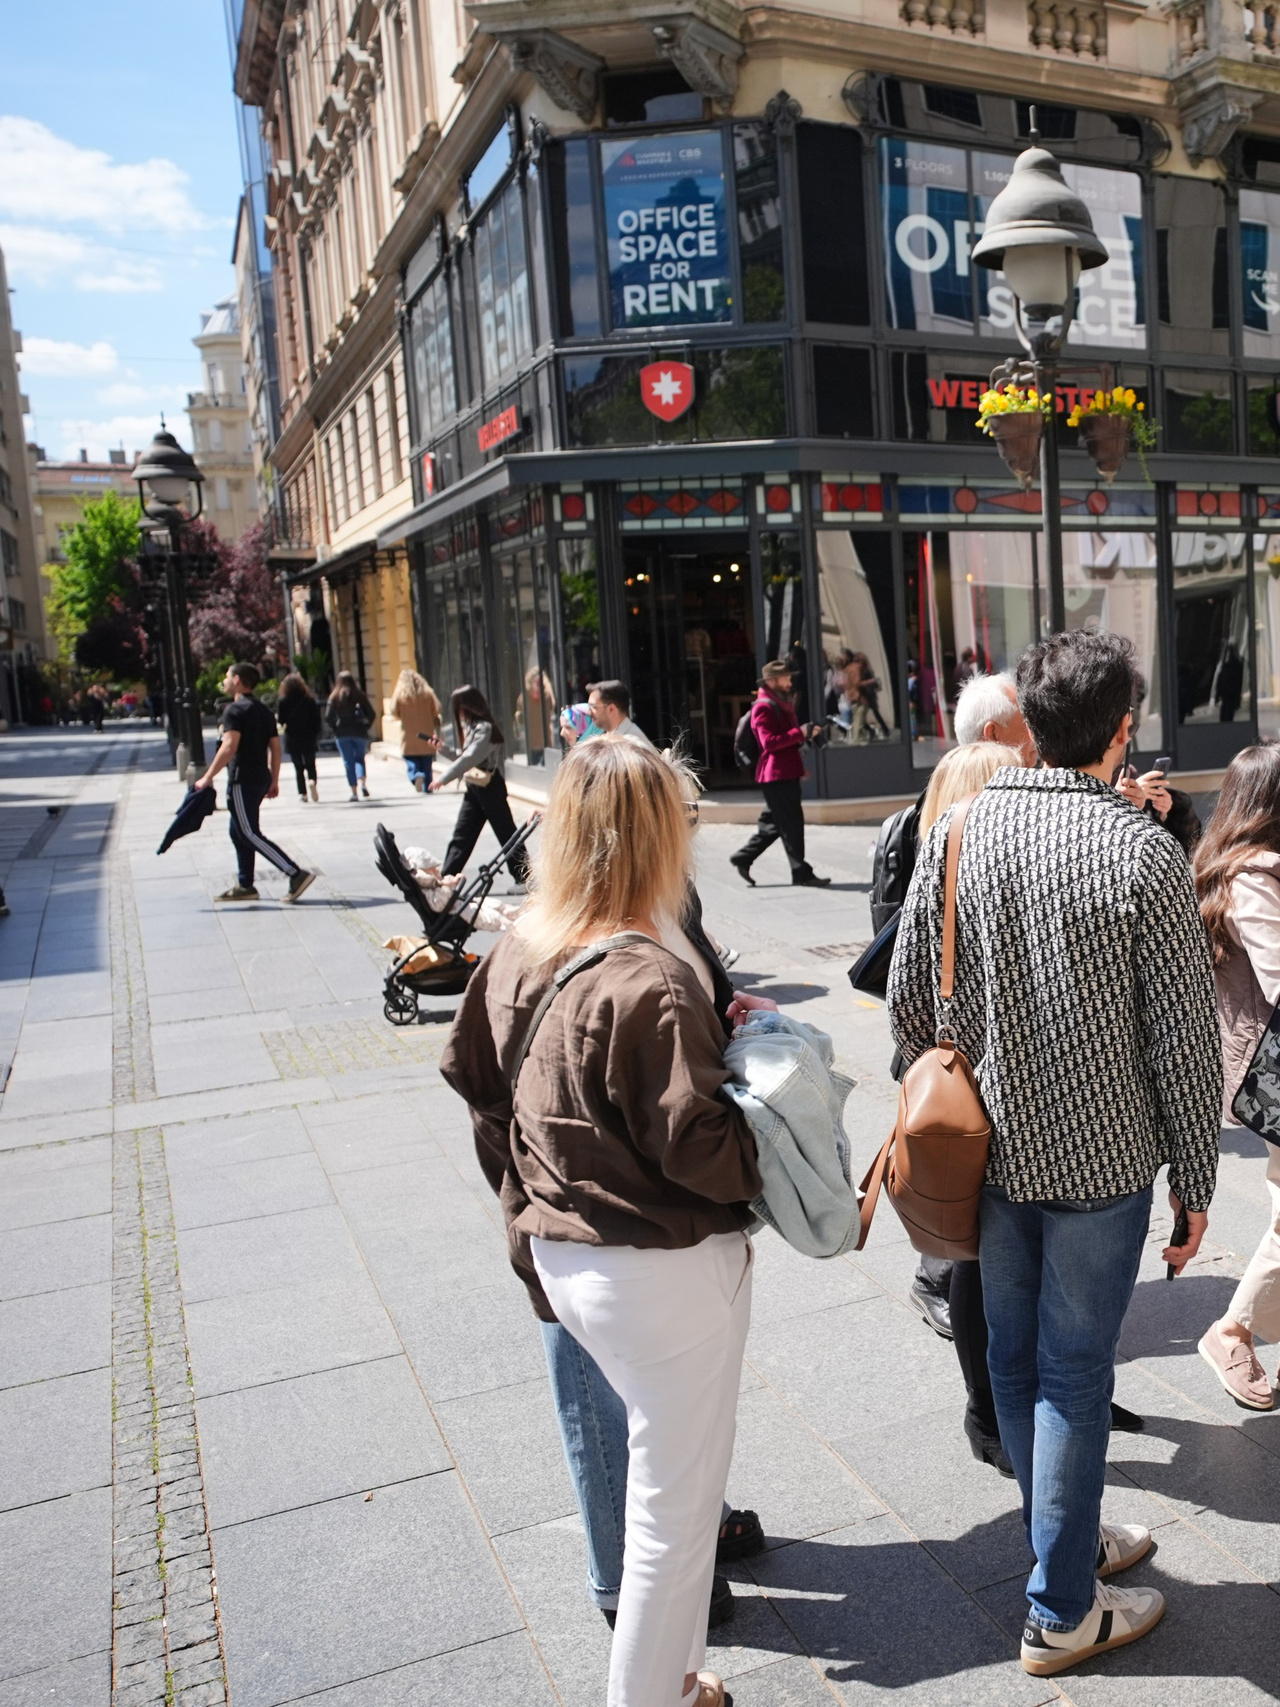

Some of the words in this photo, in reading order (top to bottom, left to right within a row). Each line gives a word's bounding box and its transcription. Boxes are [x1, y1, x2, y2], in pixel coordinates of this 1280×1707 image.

[894, 157, 903, 169] 3
[617, 203, 715, 233] OFFICE
[618, 229, 718, 263] SPACE
[650, 261, 690, 281] FOR
[1246, 268, 1278, 283] SCAN
[623, 278, 720, 316] RENT
